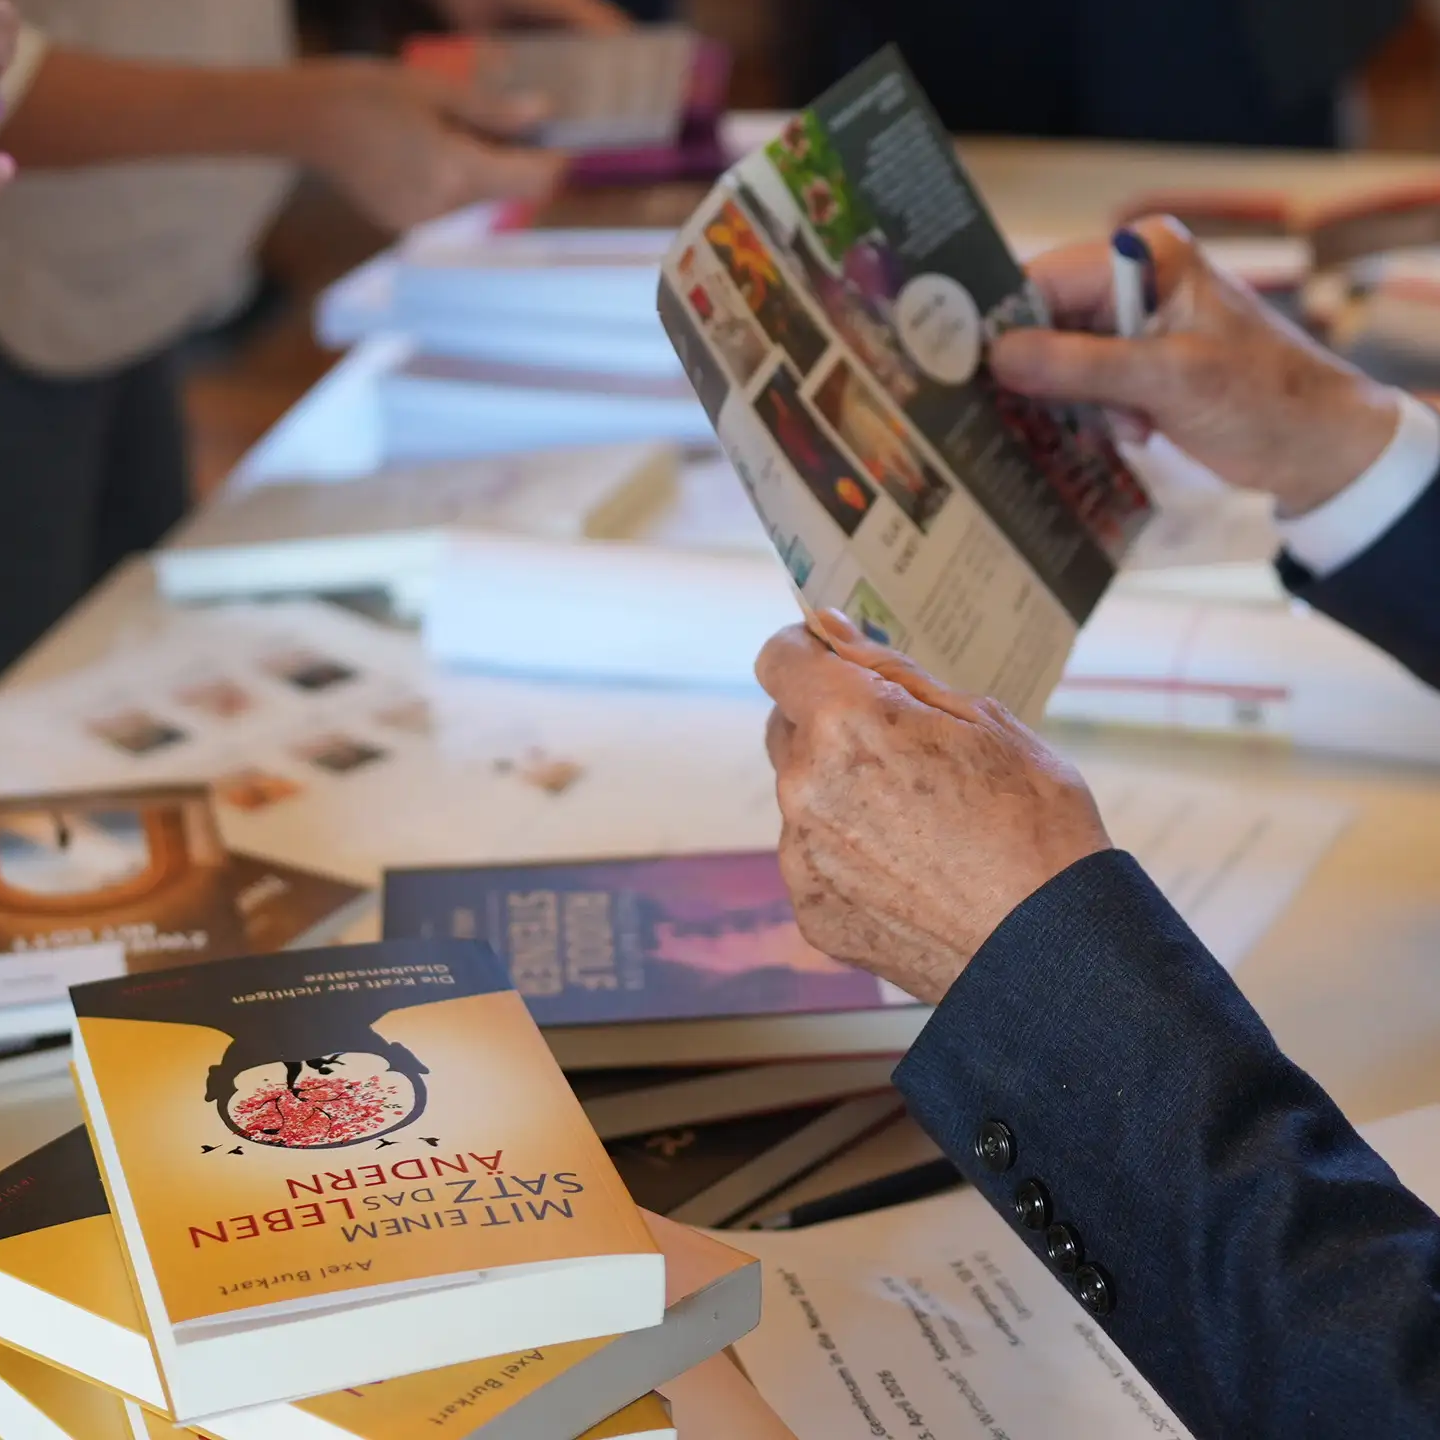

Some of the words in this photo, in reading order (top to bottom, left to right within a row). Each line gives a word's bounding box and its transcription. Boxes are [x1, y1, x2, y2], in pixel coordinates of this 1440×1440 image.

[304, 964, 450, 982] Glaubenssätze
[327, 982, 359, 992] der
[366, 976, 416, 989] Kraft
[421, 975, 455, 985] Die
[231, 985, 321, 1004] richtigen
[285, 1149, 504, 1199] ÄNDERN
[446, 1172, 584, 1204] SATZ
[363, 1188, 435, 1211] DAS
[480, 1198, 574, 1227] MIT
[188, 1198, 356, 1249] LEBEN
[341, 1209, 468, 1243] EINEM
[219, 1269, 313, 1297] Burkart
[321, 1259, 373, 1279] Axel
[500, 1349, 545, 1380] Axel
[427, 1377, 503, 1425] Burkart
